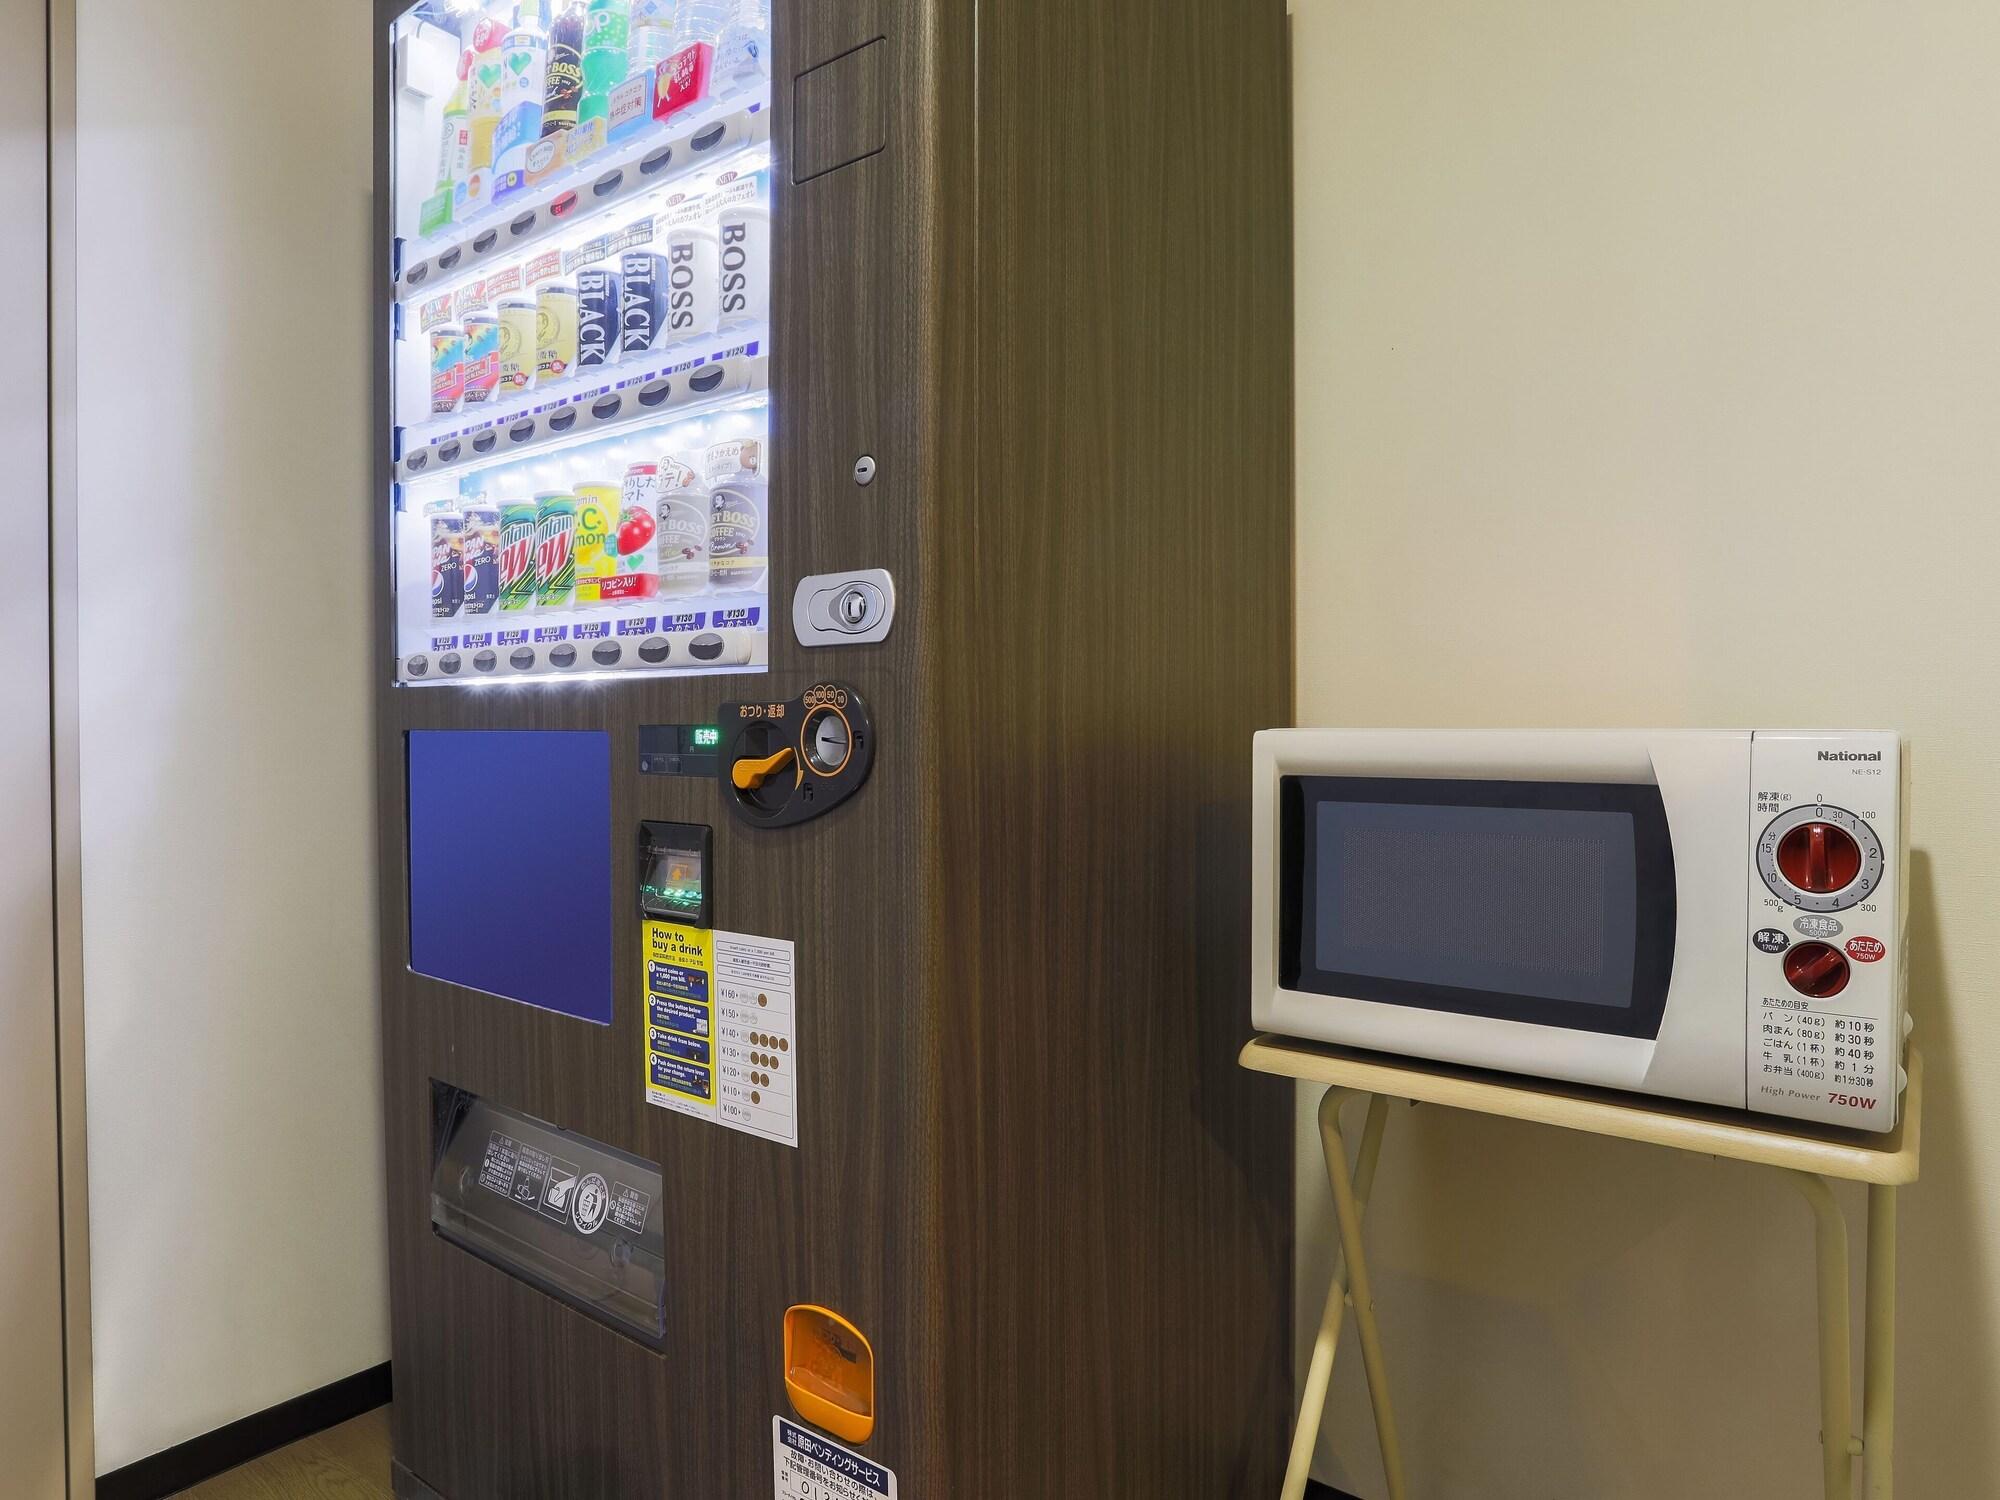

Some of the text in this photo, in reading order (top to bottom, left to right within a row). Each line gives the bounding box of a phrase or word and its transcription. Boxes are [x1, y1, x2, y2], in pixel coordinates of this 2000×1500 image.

[552, 62, 581, 77] BOSS
[722, 221, 746, 314] BOSS
[670, 242, 694, 331] BOSS
[623, 255, 650, 351] BLACK
[578, 273, 606, 366] BLACK
[584, 389, 598, 399] ¥120
[627, 376, 643, 387] ¥120
[674, 362, 692, 373] ¥120
[726, 345, 744, 358] ¥120
[722, 511, 755, 527] BOSS
[668, 519, 704, 534] BOSS
[440, 561, 457, 572] ZERO
[474, 556, 491, 567] ZERO
[544, 627, 557, 635] ¥120
[584, 623, 599, 632] ¥120
[628, 617, 644, 627] ¥120
[675, 614, 693, 623] ¥130
[727, 608, 745, 619] ¥130
[815, 690, 825, 699] 100
[826, 690, 835, 699] 50
[739, 704, 785, 718] おつり・返却
[1817, 751, 1882, 761] National
[1852, 768, 1882, 776] NE-S12
[1757, 803, 1780, 813] 時間
[1815, 807, 1823, 818] 0
[1832, 811, 1843, 819] 30
[1861, 811, 1876, 819] 100
[1851, 819, 1857, 830] 1
[1768, 831, 1776, 841] 分
[1761, 843, 1772, 854] 15
[1869, 848, 1878, 859] 2
[1767, 872, 1777, 883] 10
[1861, 878, 1870, 890] 3
[1763, 898, 1779, 907] 500
[1794, 894, 1801, 905] 5
[1831, 897, 1840, 908] 4
[1860, 903, 1877, 913] 300
[1799, 917, 1838, 932] 冷凍食品
[652, 928, 684, 942] How to
[1757, 931, 1784, 945] 解凍
[1809, 929, 1829, 937] 500W
[652, 939, 703, 956] buy a drink
[1762, 944, 1779, 952] 170W
[1850, 940, 1883, 953] あたため
[1856, 953, 1876, 961] 750W
[721, 988, 736, 999] ¥160
[1762, 997, 1809, 1011] あたための目安
[721, 1007, 736, 1019] ¥150
[1796, 1015, 1825, 1027] (40g)
[721, 1027, 736, 1038] ¥140
[1762, 1024, 1793, 1037] 肉まん
[1796, 1028, 1825, 1040] (80g)
[1763, 1038, 1793, 1050] ごはん
[722, 1046, 737, 1058] ¥130
[722, 1065, 737, 1077] ¥120
[1763, 1064, 1793, 1076] お弁当
[1796, 1069, 1825, 1081] (400g)
[722, 1084, 737, 1096] ¥110
[1760, 1085, 1877, 1110] High Power 750W
[723, 1103, 738, 1115] ¥100
